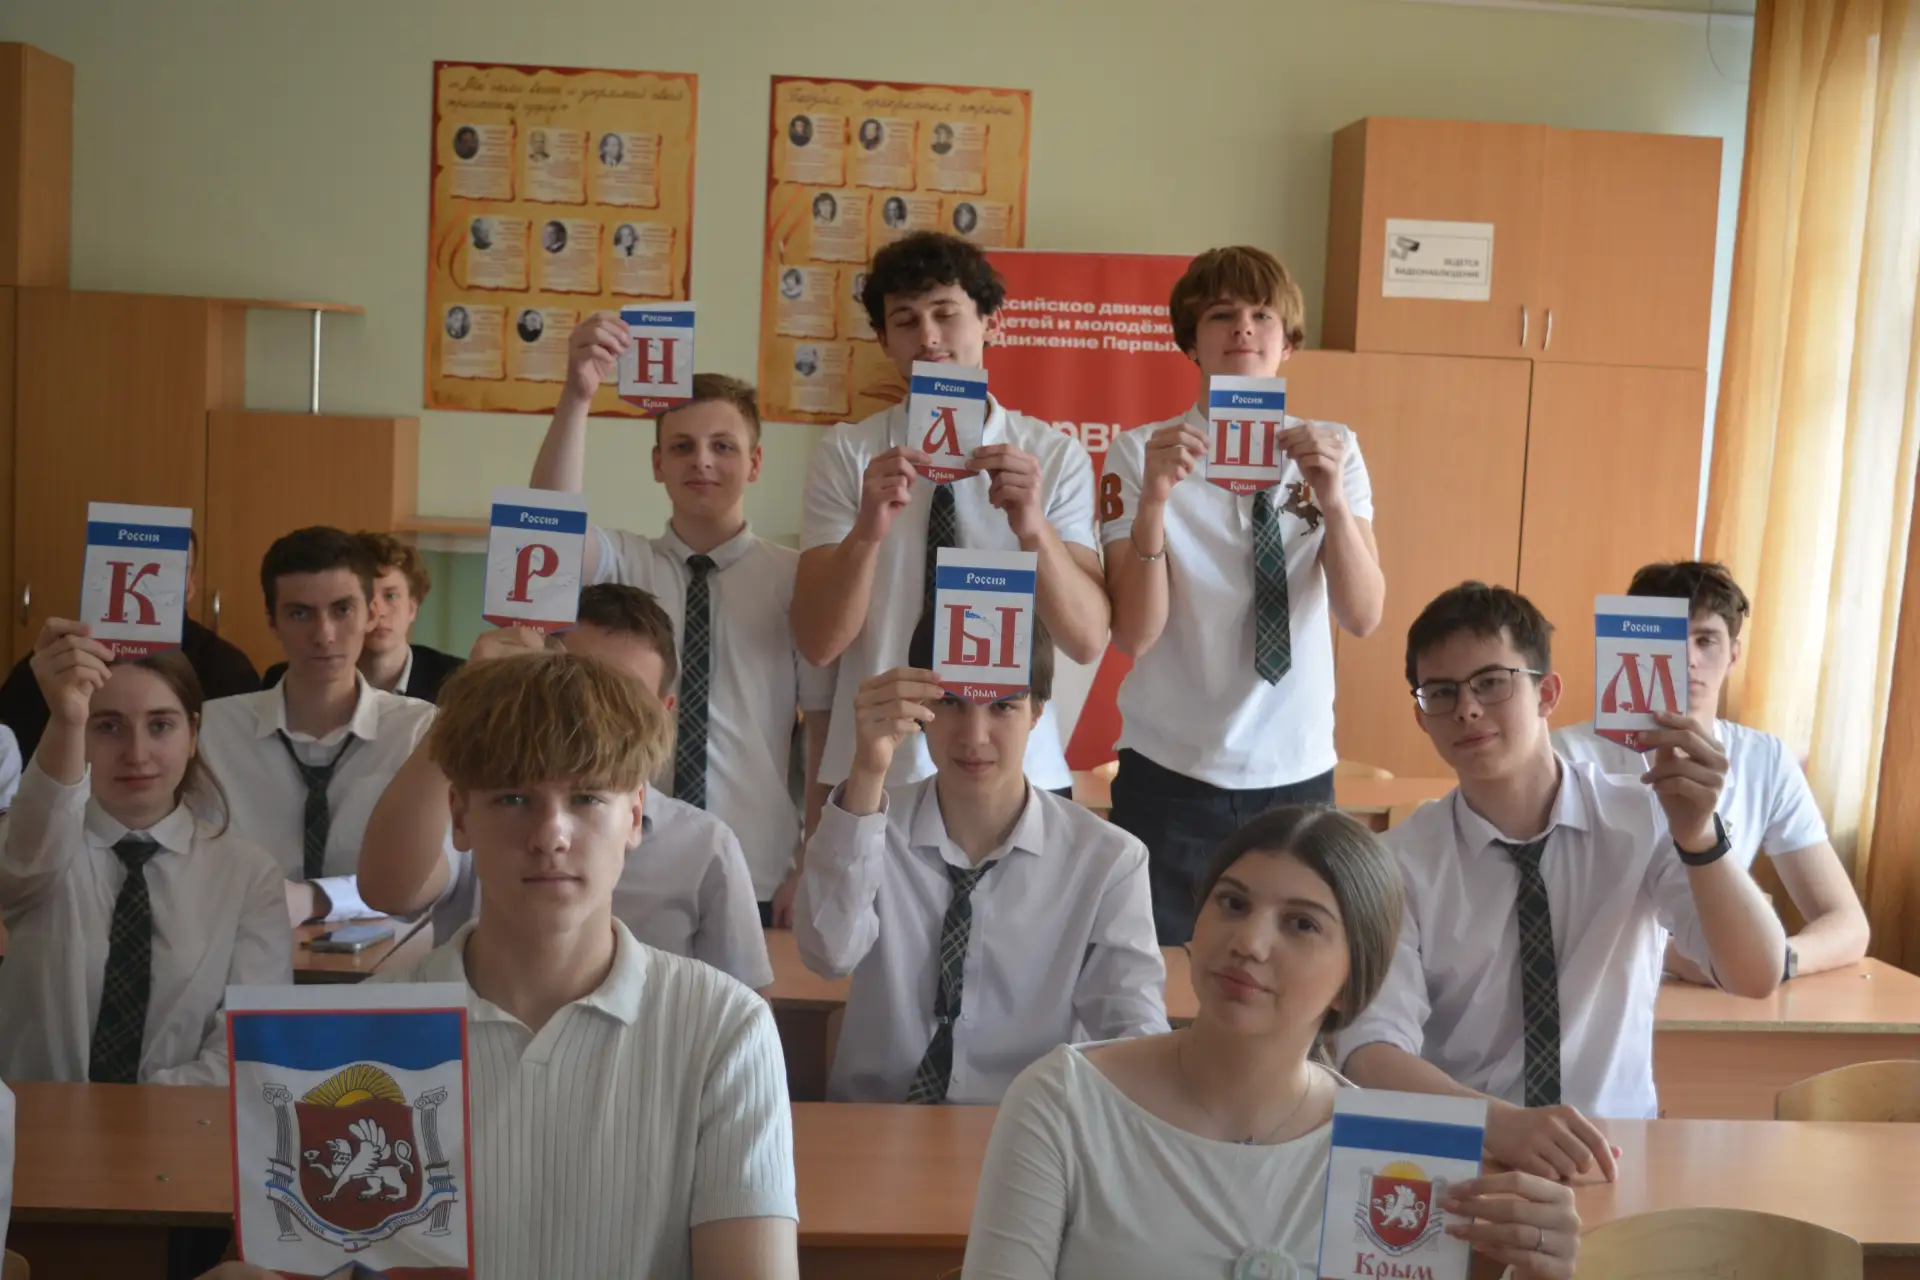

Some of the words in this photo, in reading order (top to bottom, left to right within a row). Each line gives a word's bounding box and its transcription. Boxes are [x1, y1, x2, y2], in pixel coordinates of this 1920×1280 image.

[641, 313, 672, 322] Россия
[1058, 319, 1071, 330] и
[991, 332, 1099, 349] Движение
[633, 336, 679, 385] Н
[934, 381, 965, 393] Россия
[1231, 394, 1263, 405] Россия
[922, 406, 965, 456] А
[1210, 419, 1281, 467] Ш
[928, 468, 955, 481] Крым
[1230, 480, 1257, 491] Крым
[520, 511, 559, 526] Россия
[118, 528, 160, 543] Россия
[506, 543, 559, 603] Р
[966, 572, 1006, 586] Россия
[101, 561, 161, 625] К
[1622, 620, 1660, 634] Россия
[941, 604, 1023, 668] Ы
[111, 642, 148, 656] Крым
[1601, 652, 1683, 715] М
[963, 685, 998, 700] Крым
[1353, 1251, 1434, 1280] Крым
